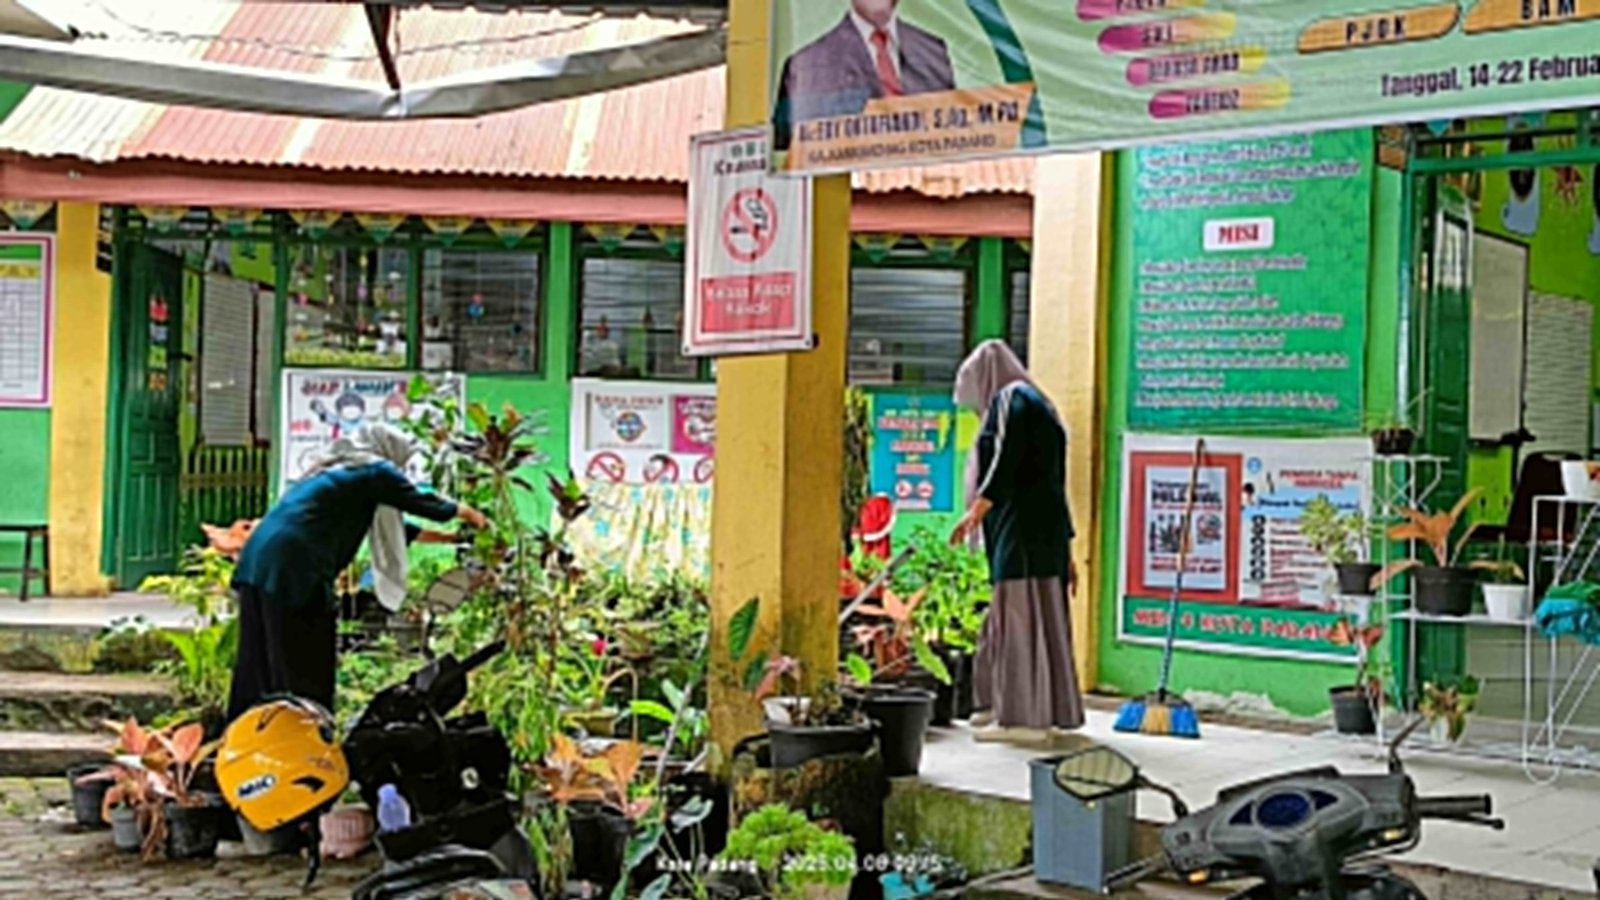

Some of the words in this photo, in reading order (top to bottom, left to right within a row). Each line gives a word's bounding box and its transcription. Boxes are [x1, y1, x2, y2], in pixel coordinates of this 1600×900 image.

[1345, 16, 1406, 42] PJOK
[1380, 67, 1464, 97] Tanggal,
[1217, 223, 1261, 245] MISI
